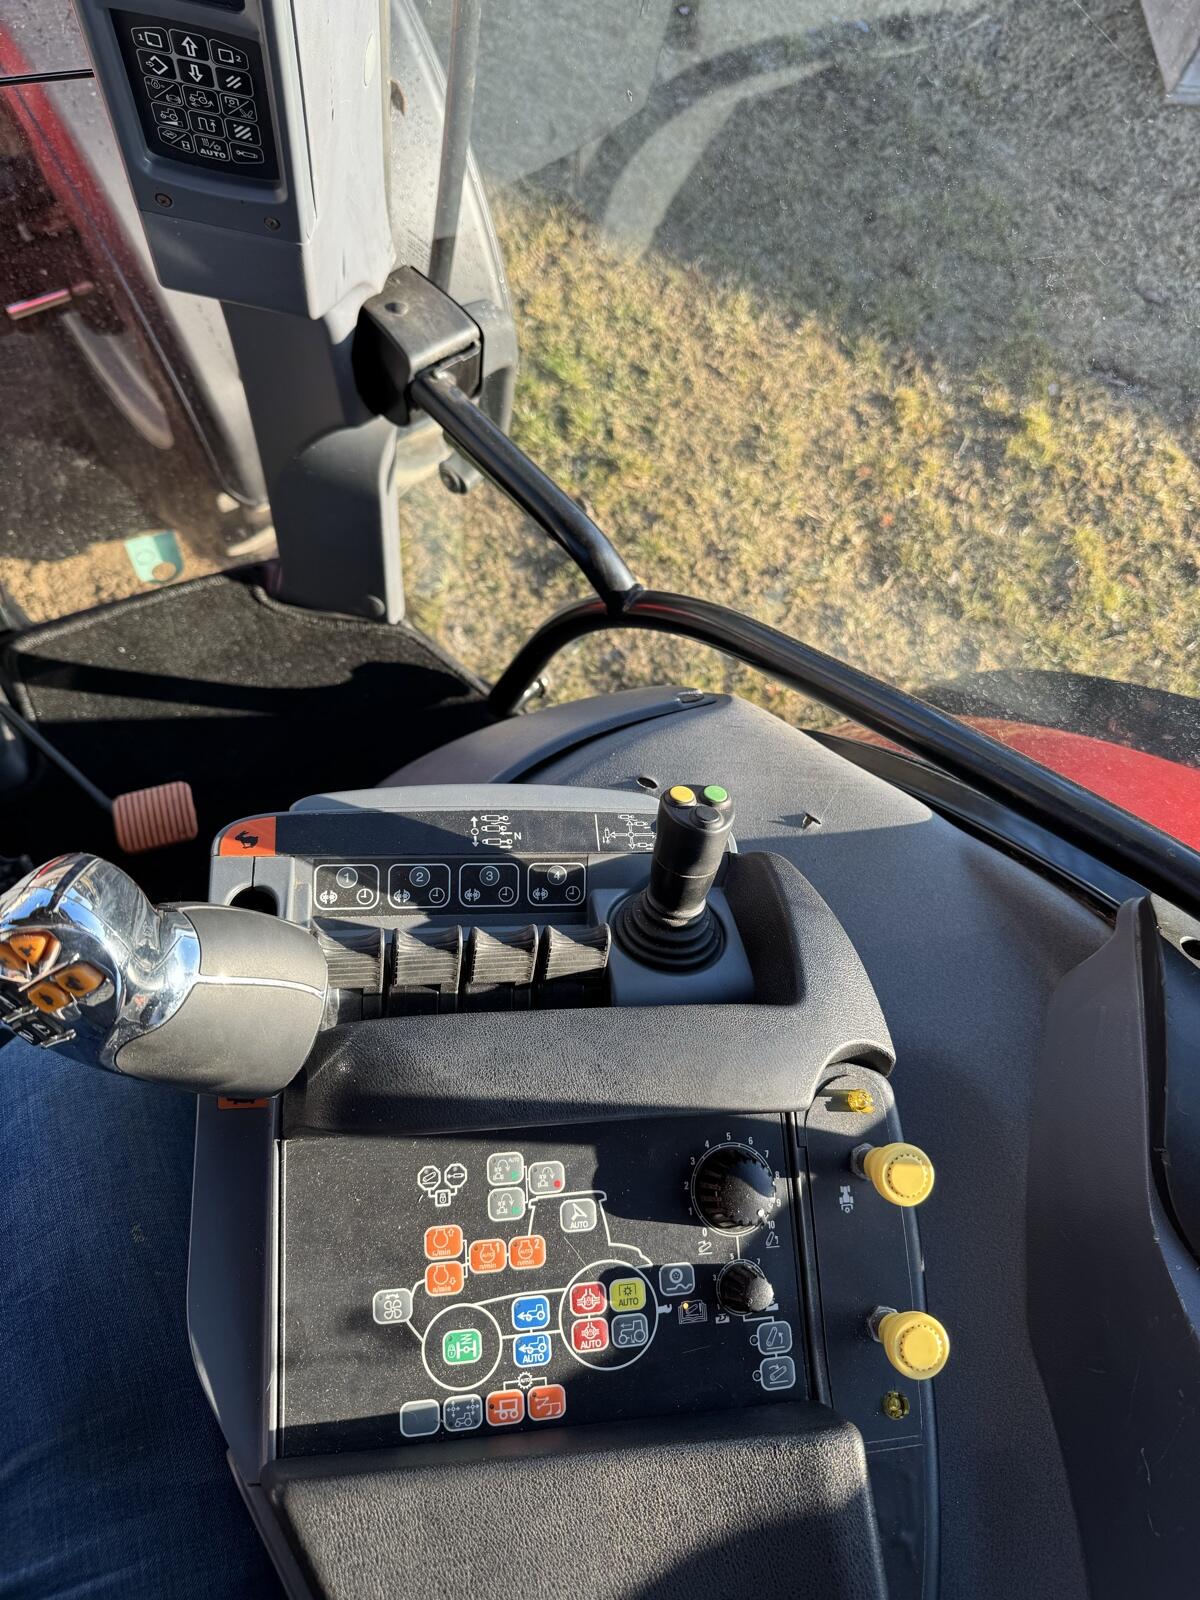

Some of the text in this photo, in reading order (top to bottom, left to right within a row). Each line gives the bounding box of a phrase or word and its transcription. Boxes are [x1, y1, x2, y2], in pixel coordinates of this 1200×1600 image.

[200, 149, 226, 159] AUTO
[514, 832, 522, 840] N
[344, 872, 349, 883] 1
[416, 872, 424, 882] 2
[486, 871, 494, 881] 3
[553, 870, 561, 881] 4
[726, 1132, 732, 1141] 5
[748, 1137, 754, 1145] 6
[704, 1140, 710, 1149] 4
[764, 1150, 769, 1158] 7
[690, 1157, 696, 1166] 3
[774, 1171, 780, 1179] 8
[684, 1182, 689, 1190] 2
[776, 1199, 782, 1207] 9
[688, 1208, 693, 1216] 1
[570, 1220, 589, 1229] AUTO
[768, 1221, 776, 1229] 10
[702, 1227, 708, 1237] 0
[534, 1239, 540, 1249] 2
[618, 1297, 639, 1306] AUTO
[580, 1340, 601, 1349] AUTO
[522, 1353, 545, 1363] AUTO
